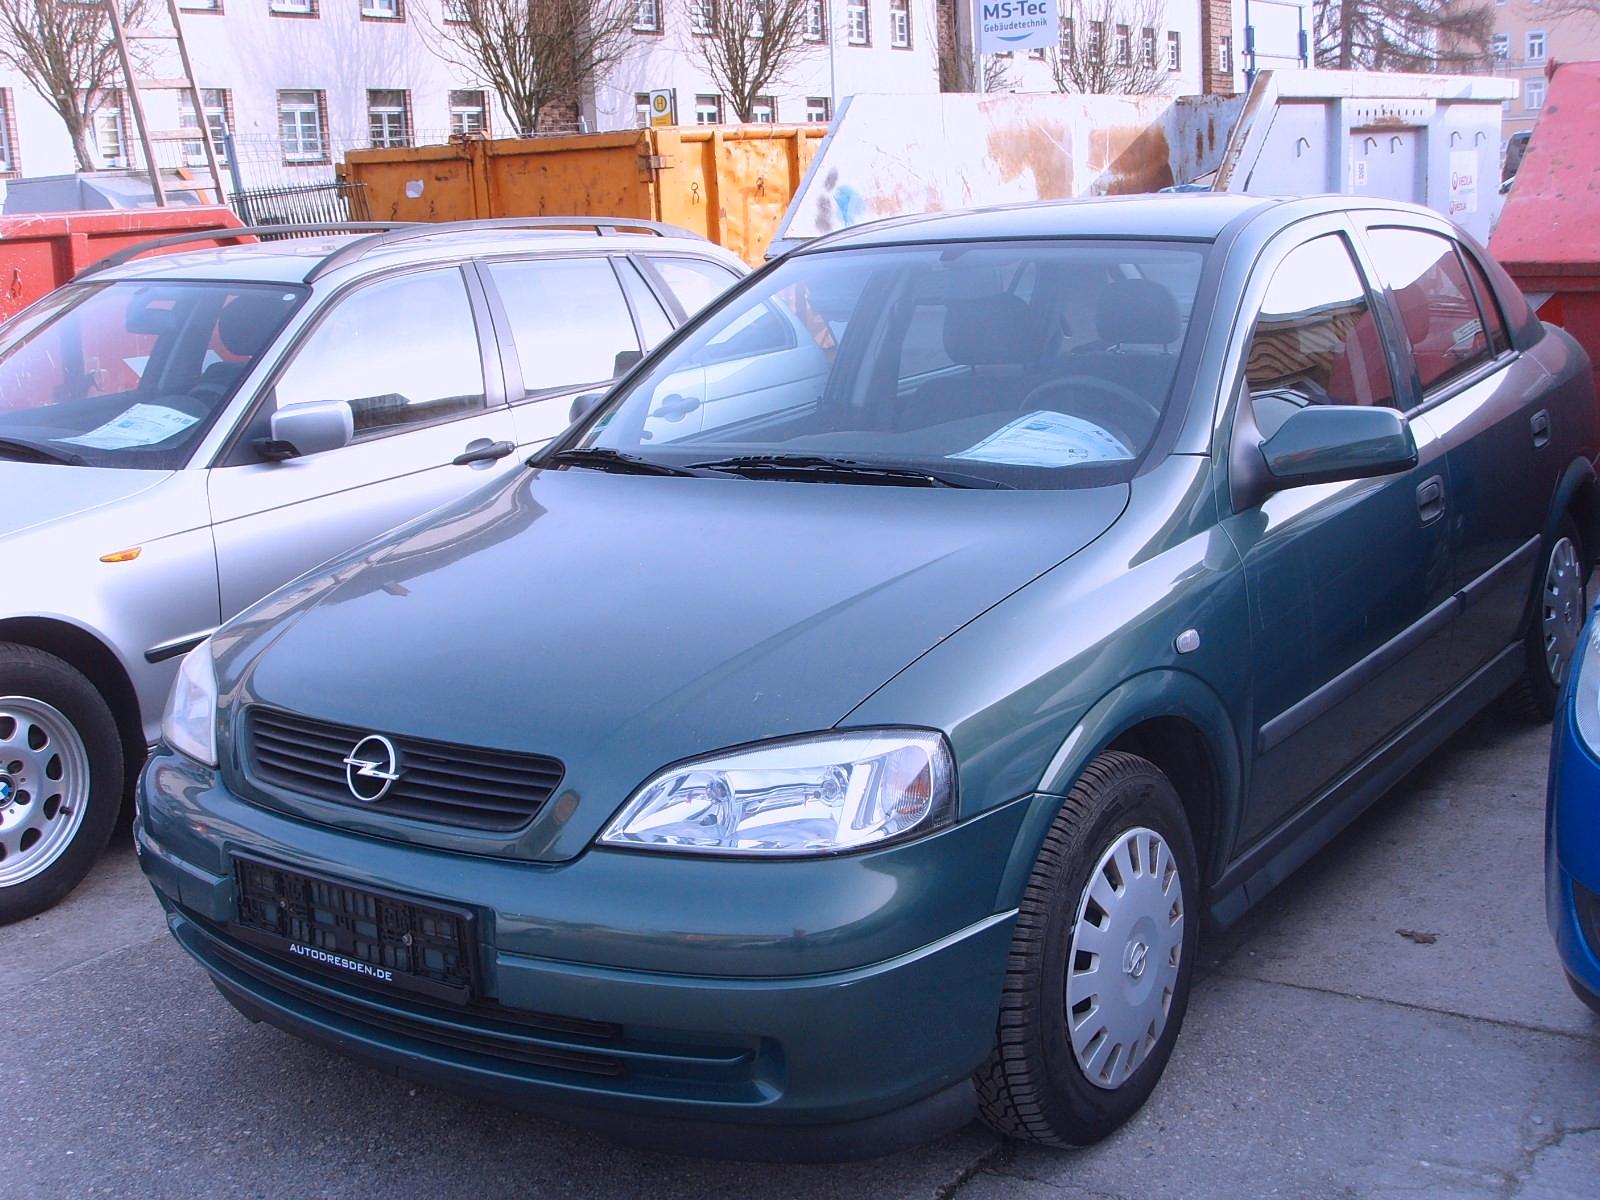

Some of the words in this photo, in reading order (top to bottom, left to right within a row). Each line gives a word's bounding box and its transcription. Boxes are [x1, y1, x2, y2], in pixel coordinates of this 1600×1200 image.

[984, 0, 1047, 20] MS-Tec
[984, 18, 1048, 32] Gebäudetechnik
[289, 943, 393, 981] AUTODRESDEN.DE
